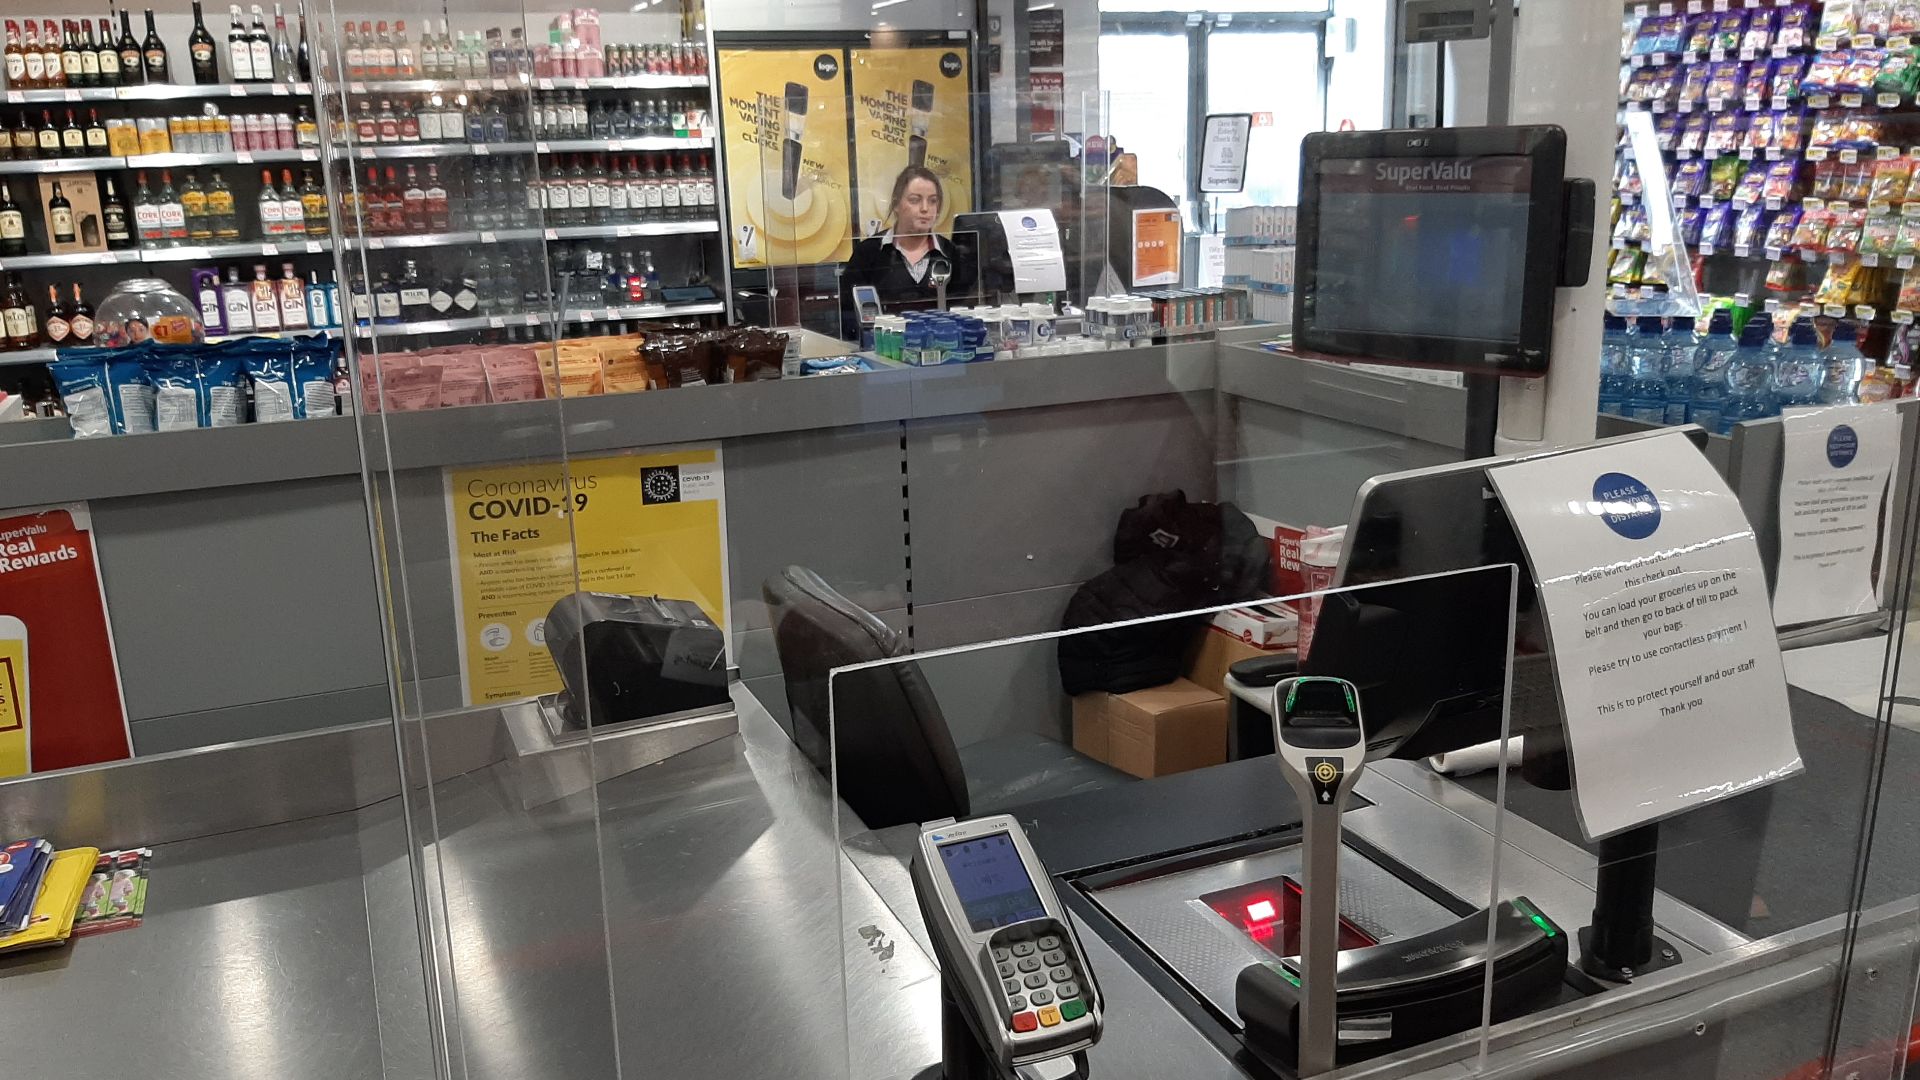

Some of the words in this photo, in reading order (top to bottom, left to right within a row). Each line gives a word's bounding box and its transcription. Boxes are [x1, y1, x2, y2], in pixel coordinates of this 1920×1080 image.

[756, 91, 780, 108] THE
[885, 89, 908, 106] THE
[860, 95, 907, 118] MOMENT
[868, 108, 907, 129] VAPING
[882, 124, 906, 139] JUST
[803, 158, 825, 170] NEW
[927, 154, 948, 166] NEW
[1375, 161, 1472, 187] SuperValu
[138, 211, 158, 219] CORK
[161, 210, 182, 218] CORK
[202, 303, 219, 313] GIN
[228, 302, 249, 312] GIN
[255, 303, 276, 312] GIN
[283, 299, 304, 309] GIN
[467, 472, 598, 498] Coronavirus
[1603, 485, 1638, 500] PLEASE
[469, 493, 588, 521] COVID-19
[1610, 511, 1655, 524] DISTA
[0, 524, 47, 543] uperValu
[470, 531, 499, 543] The
[502, 528, 540, 541] Facts
[0, 536, 36, 557] Real
[1279, 545, 1299, 560] Real
[0, 544, 78, 573] Rewards
[1574, 570, 1602, 585] Please
[1604, 566, 1622, 577] wait
[1624, 578, 1641, 588] this
[1583, 609, 1600, 621] You
[1601, 606, 1617, 617] can
[1618, 597, 1636, 611] load
[1637, 596, 1657, 609] your
[1658, 582, 1696, 602] groceries
[1697, 578, 1709, 589] up
[1710, 575, 1722, 585] on
[1722, 570, 1737, 582] the
[478, 610, 517, 619] Prevention
[1584, 625, 1601, 639] belt
[1603, 621, 1619, 634] and
[1620, 615, 1641, 628] then
[1642, 612, 1653, 624] go
[1654, 608, 1664, 618] to
[1665, 602, 1685, 615] back
[1686, 597, 1696, 608] of
[1696, 594, 1707, 606] till
[1708, 592, 1718, 602] to
[1719, 586, 1739, 600] pack
[1642, 626, 1662, 640] your
[1588, 662, 1616, 677] Please
[1617, 656, 1630, 668] try
[1631, 653, 1642, 663] to
[1643, 649, 1658, 660] use
[1659, 635, 1705, 655] contactless
[1706, 623, 1743, 643] payment
[485, 690, 521, 699] Symptoms
[1597, 702, 1616, 716] This
[1616, 700, 1624, 710] is
[1625, 697, 1636, 707] to
[1637, 687, 1669, 706] protect
[1669, 674, 1703, 695] yourself
[1704, 669, 1720, 684] and
[1721, 665, 1736, 678] our
[1737, 658, 1756, 673] staff
[1659, 702, 1686, 717] Thank
[1687, 697, 1704, 711] you
[996, 950, 1002, 958] 1
[1020, 944, 1028, 952] 2
[1047, 938, 1053, 946] 3
[1052, 953, 1059, 961] 6
[1006, 982, 1012, 990] 7
[1033, 975, 1040, 984] 8
[1059, 970, 1066, 978] 9
[1039, 992, 1047, 1000] 0
